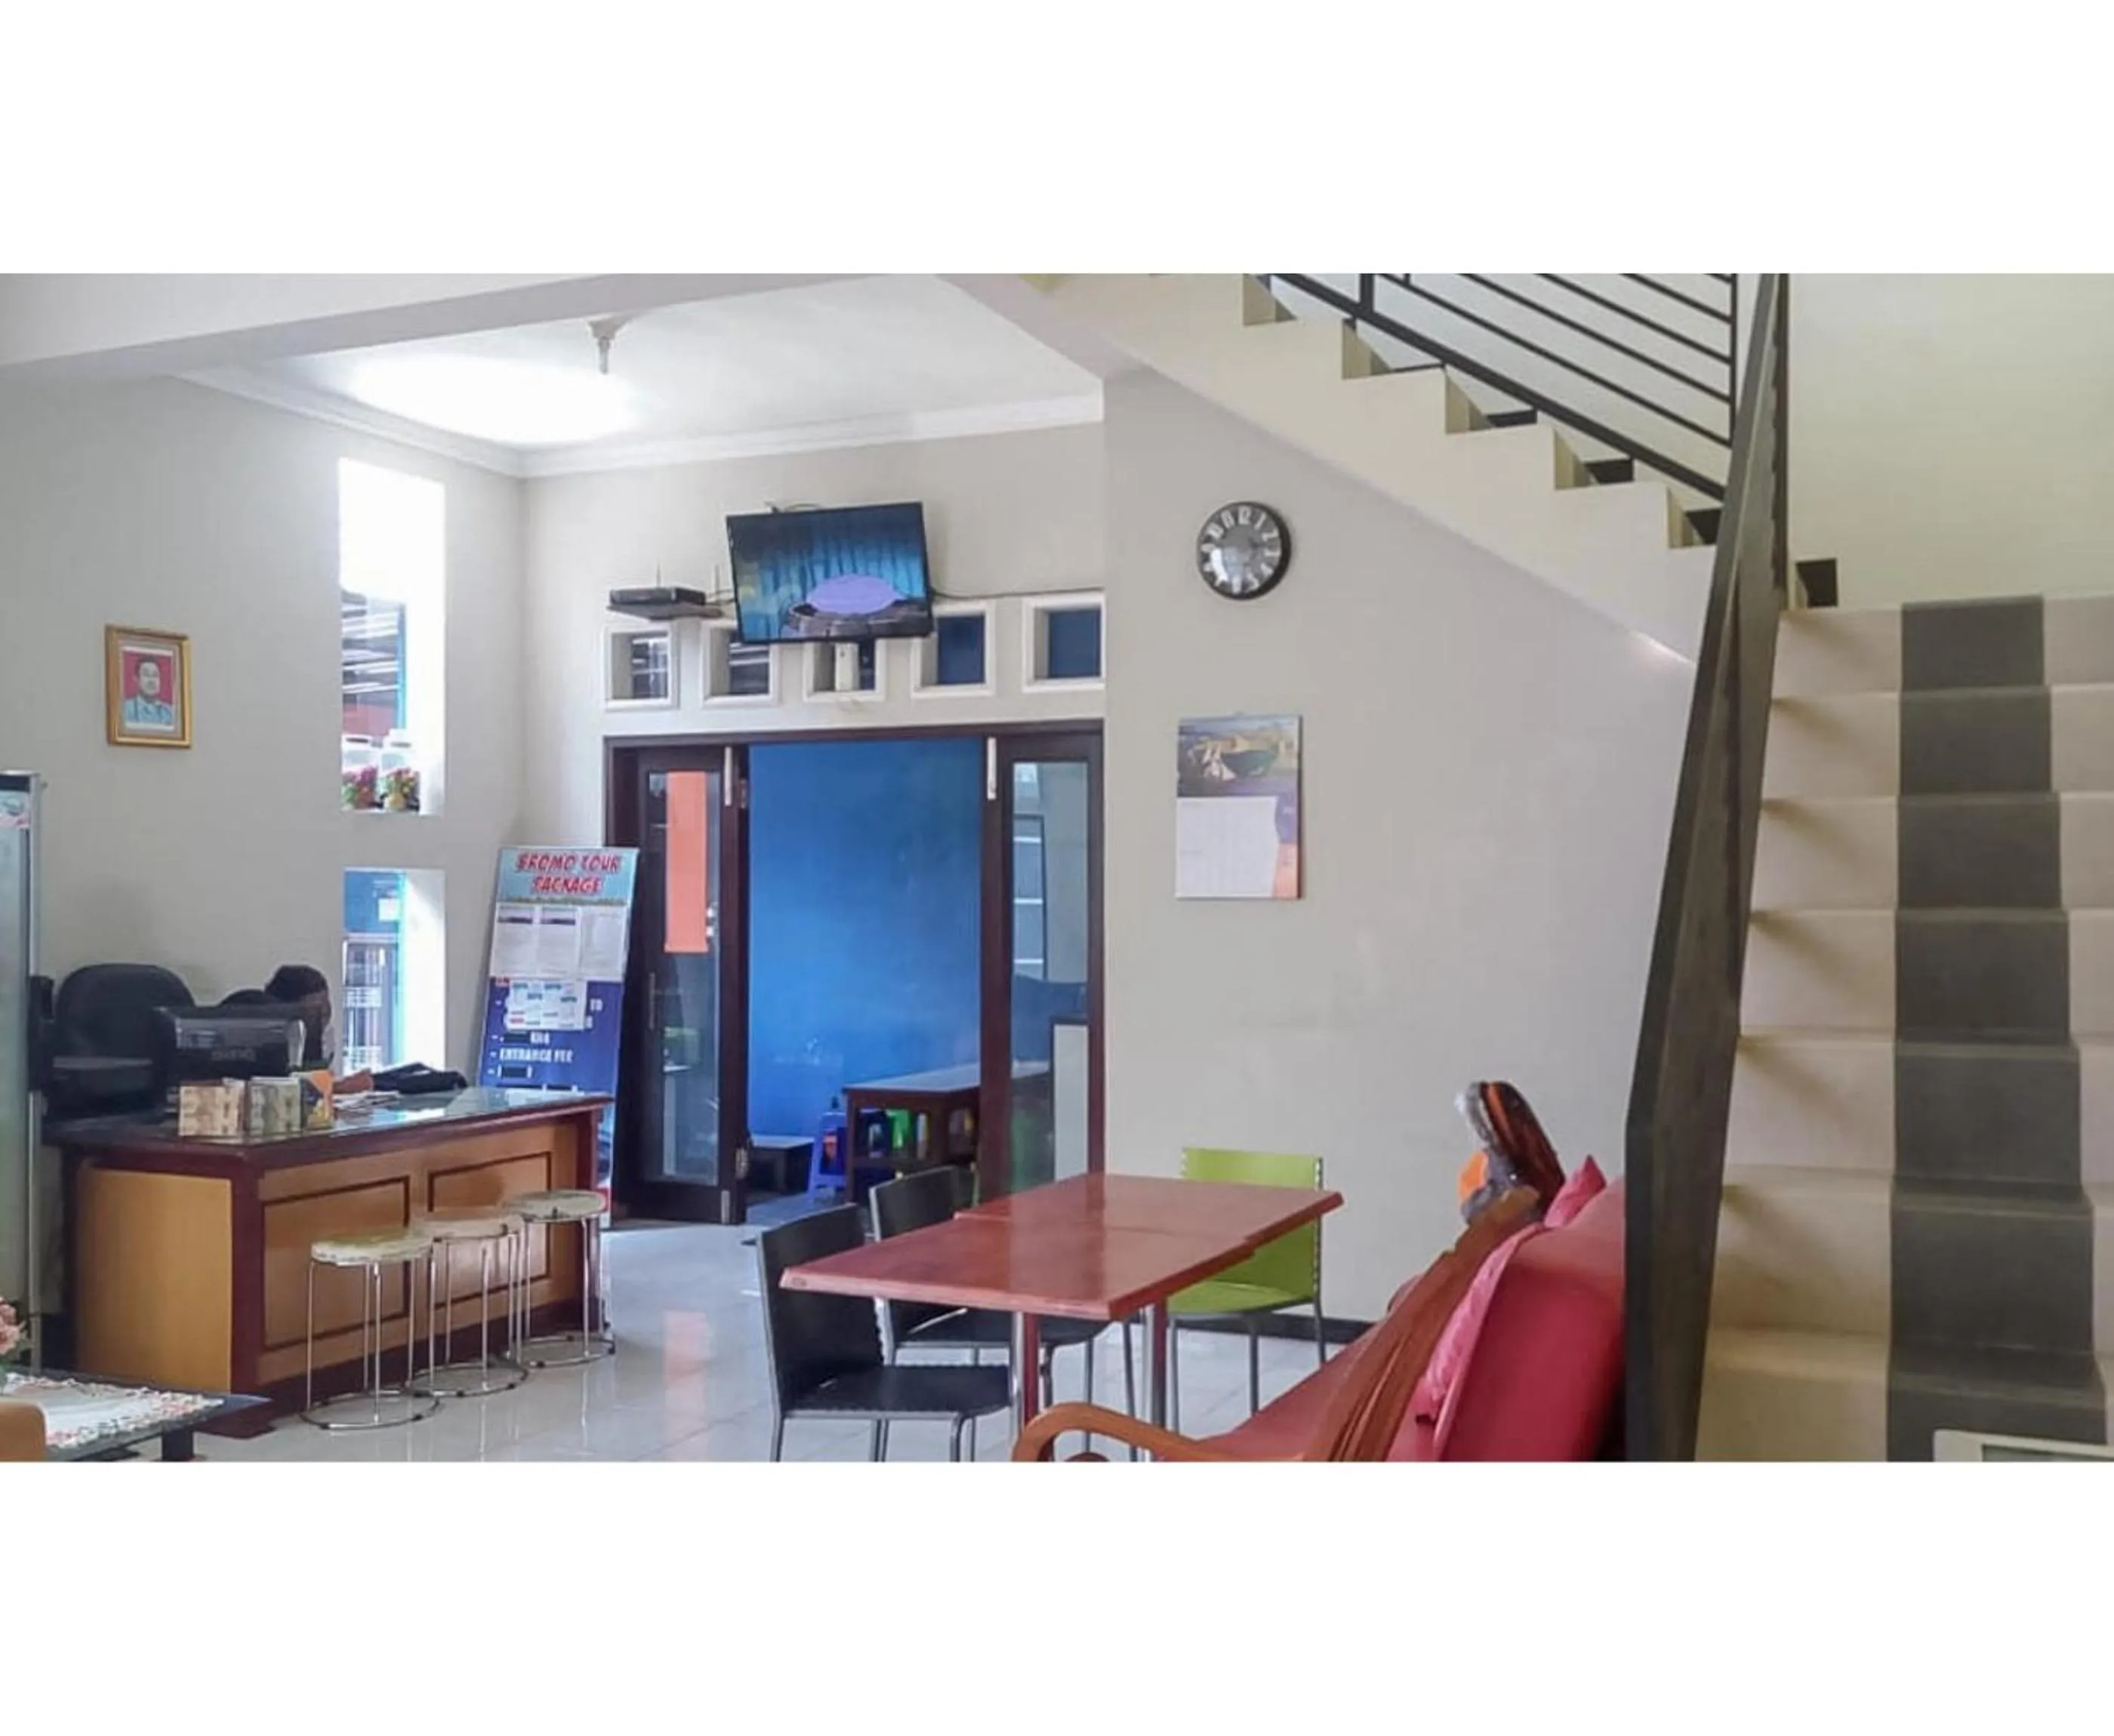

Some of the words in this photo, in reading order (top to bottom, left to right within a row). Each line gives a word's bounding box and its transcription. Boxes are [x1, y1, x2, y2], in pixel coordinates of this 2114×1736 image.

[581, 853, 622, 873] TOUR
[532, 875, 602, 894] PACKAGE
[499, 1047, 552, 1063] ENTRANCE
